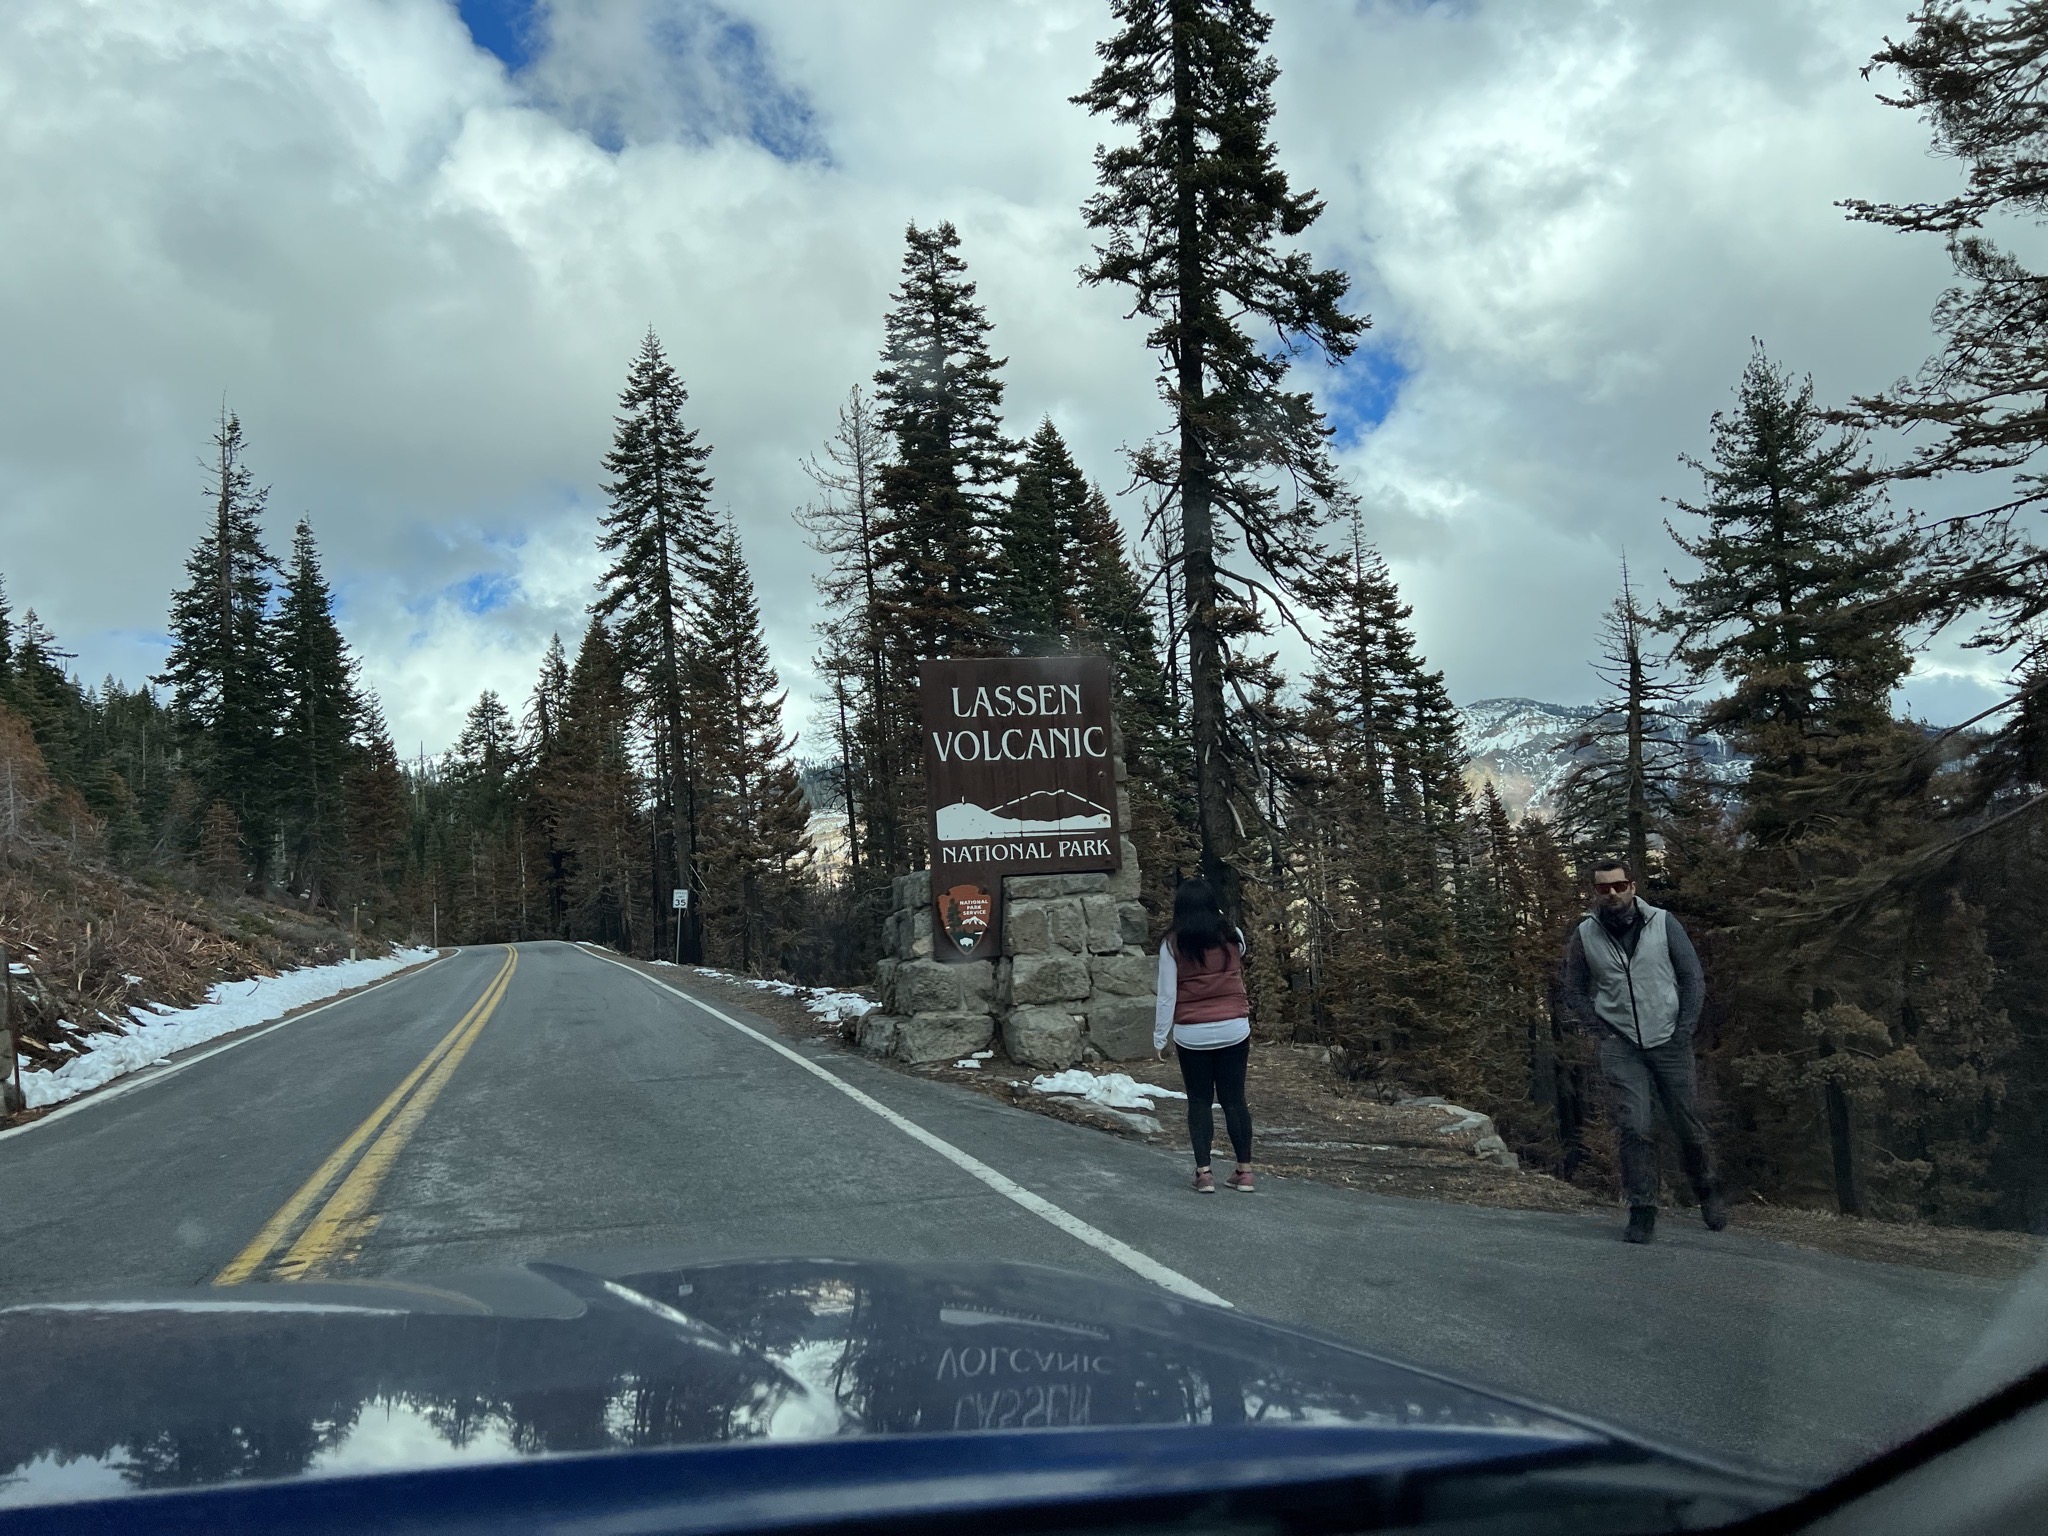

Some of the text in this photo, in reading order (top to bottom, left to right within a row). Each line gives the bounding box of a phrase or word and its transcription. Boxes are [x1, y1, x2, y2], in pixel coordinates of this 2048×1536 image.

[951, 684, 1082, 718] LASSEN
[932, 726, 1107, 762] VOLCANIC
[942, 839, 1112, 863] NATIONAL PARK
[674, 898, 686, 906] 35
